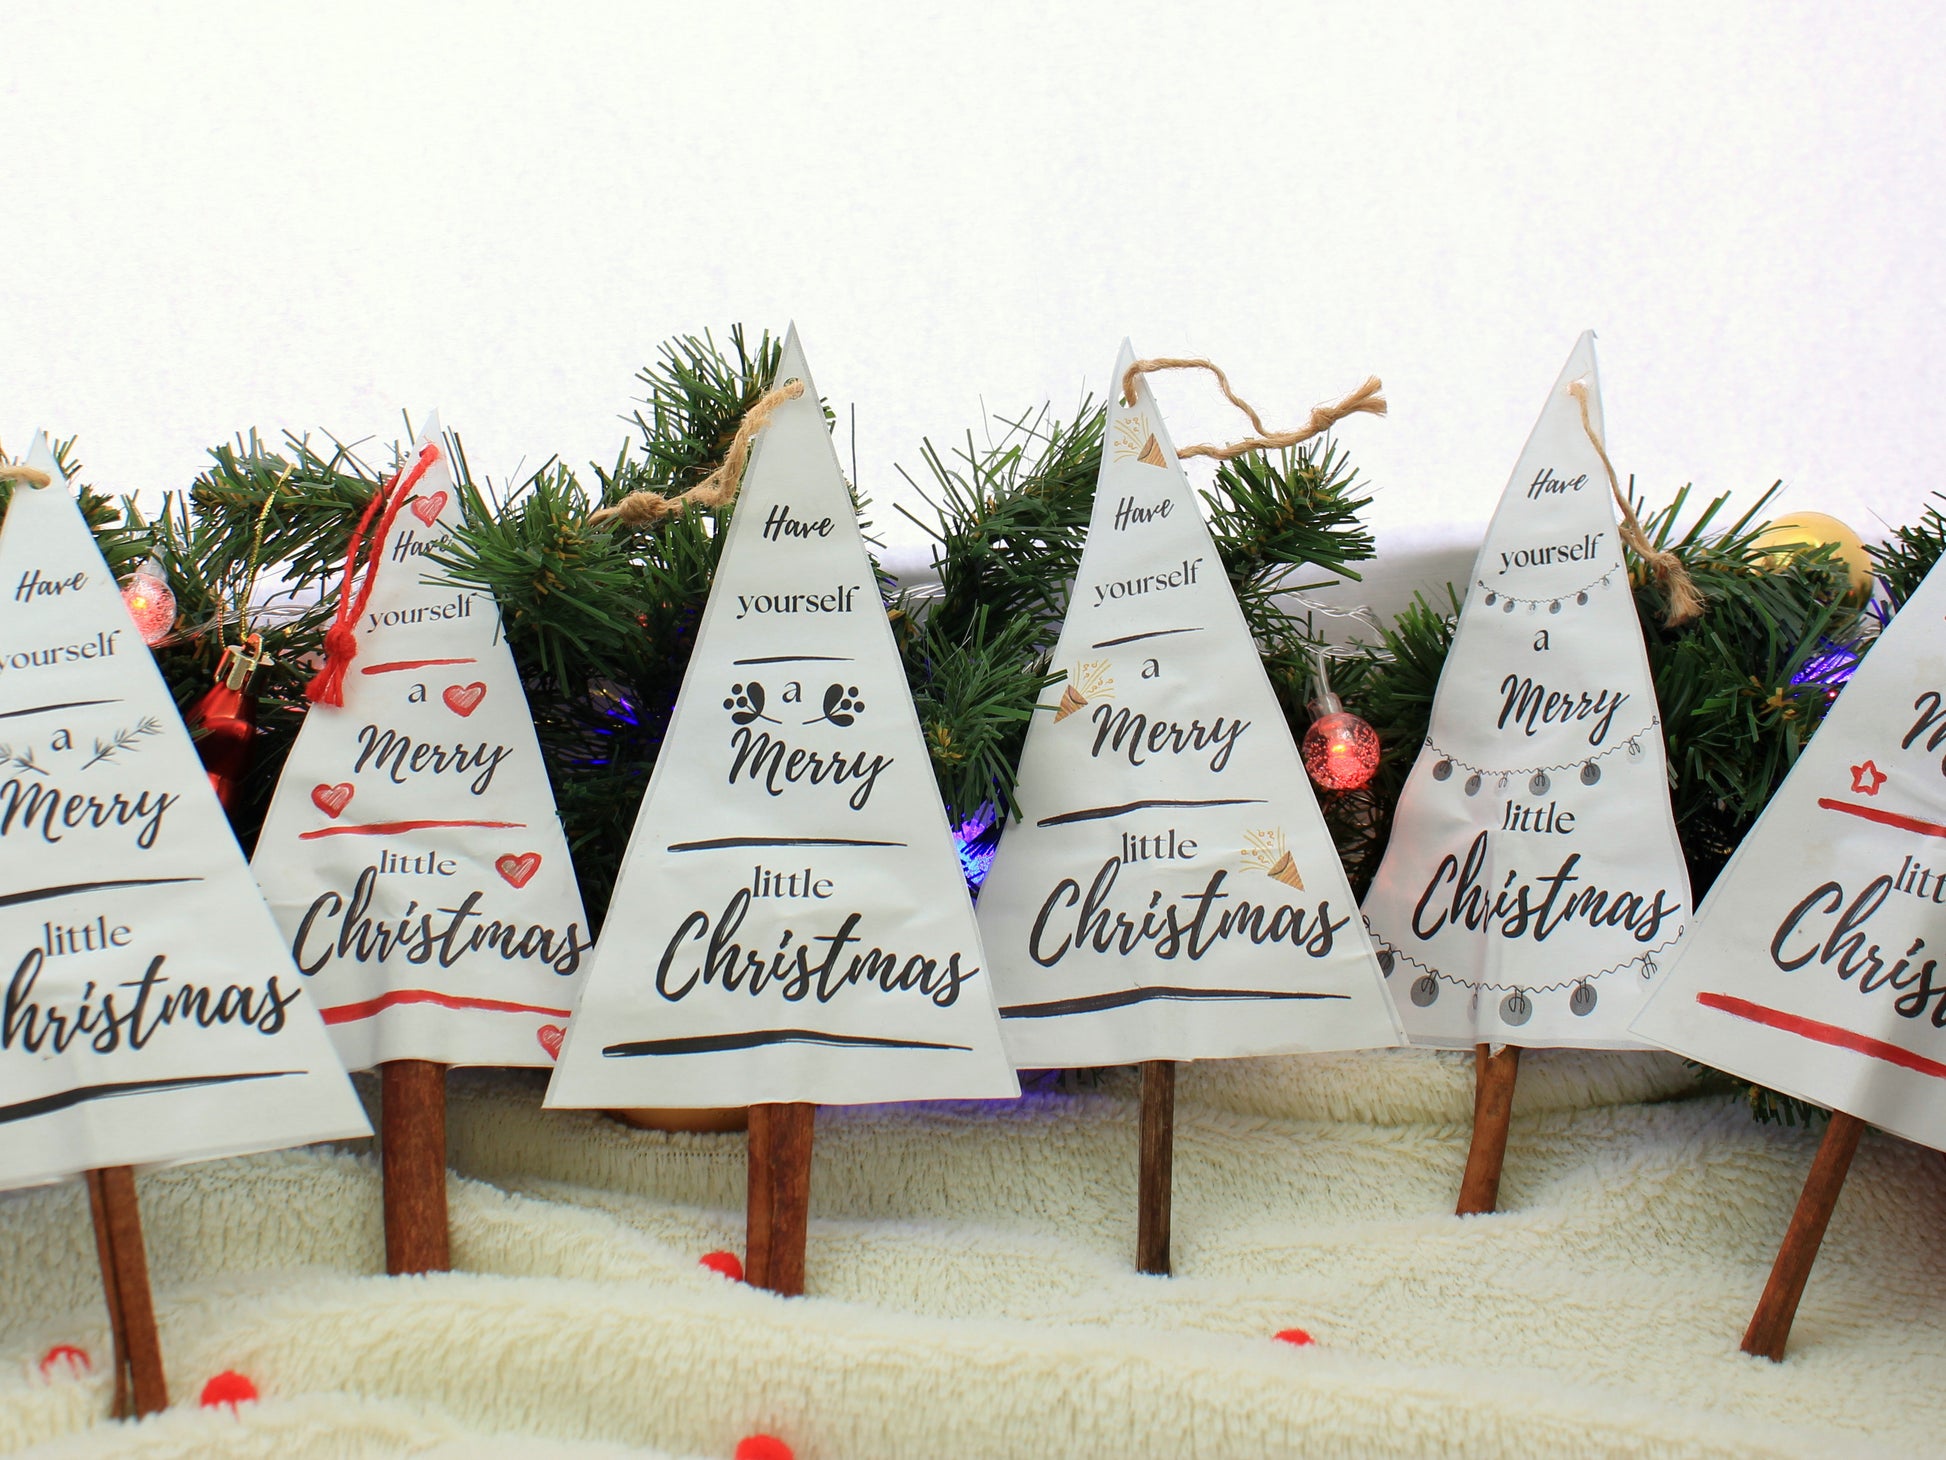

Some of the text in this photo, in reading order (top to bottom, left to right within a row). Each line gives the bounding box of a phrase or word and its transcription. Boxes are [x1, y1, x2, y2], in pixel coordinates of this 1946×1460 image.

[1526, 467, 1589, 501] Have
[762, 504, 836, 542] Have
[1114, 495, 1175, 532] Have
[1498, 532, 1604, 576] yourself
[15, 569, 89, 603] Have
[736, 584, 861, 620] yourself
[1093, 557, 1204, 608] yourself
[366, 592, 477, 634] yourself
[1533, 629, 1550, 652] a
[1141, 658, 1160, 680] a
[408, 683, 427, 704] a
[781, 681, 802, 704] a
[1497, 673, 1630, 746] Merry
[51, 728, 73, 752] a
[1091, 703, 1252, 773] Merry
[354, 724, 514, 796] Merry
[728, 726, 895, 811] Merry
[0, 778, 180, 850] Merry
[1501, 799, 1576, 835] little
[378, 849, 457, 876] little
[1120, 828, 1198, 865] little
[750, 865, 834, 899] little
[1411, 829, 1681, 942] Christmas
[1893, 855, 1946, 904] litt
[291, 865, 593, 976] Christmas
[1028, 856, 1351, 968] Christmas
[43, 915, 131, 957] little
[655, 887, 981, 1008] Christmas
[1770, 874, 1946, 1028] Chris
[2, 947, 300, 1054] hristmas
